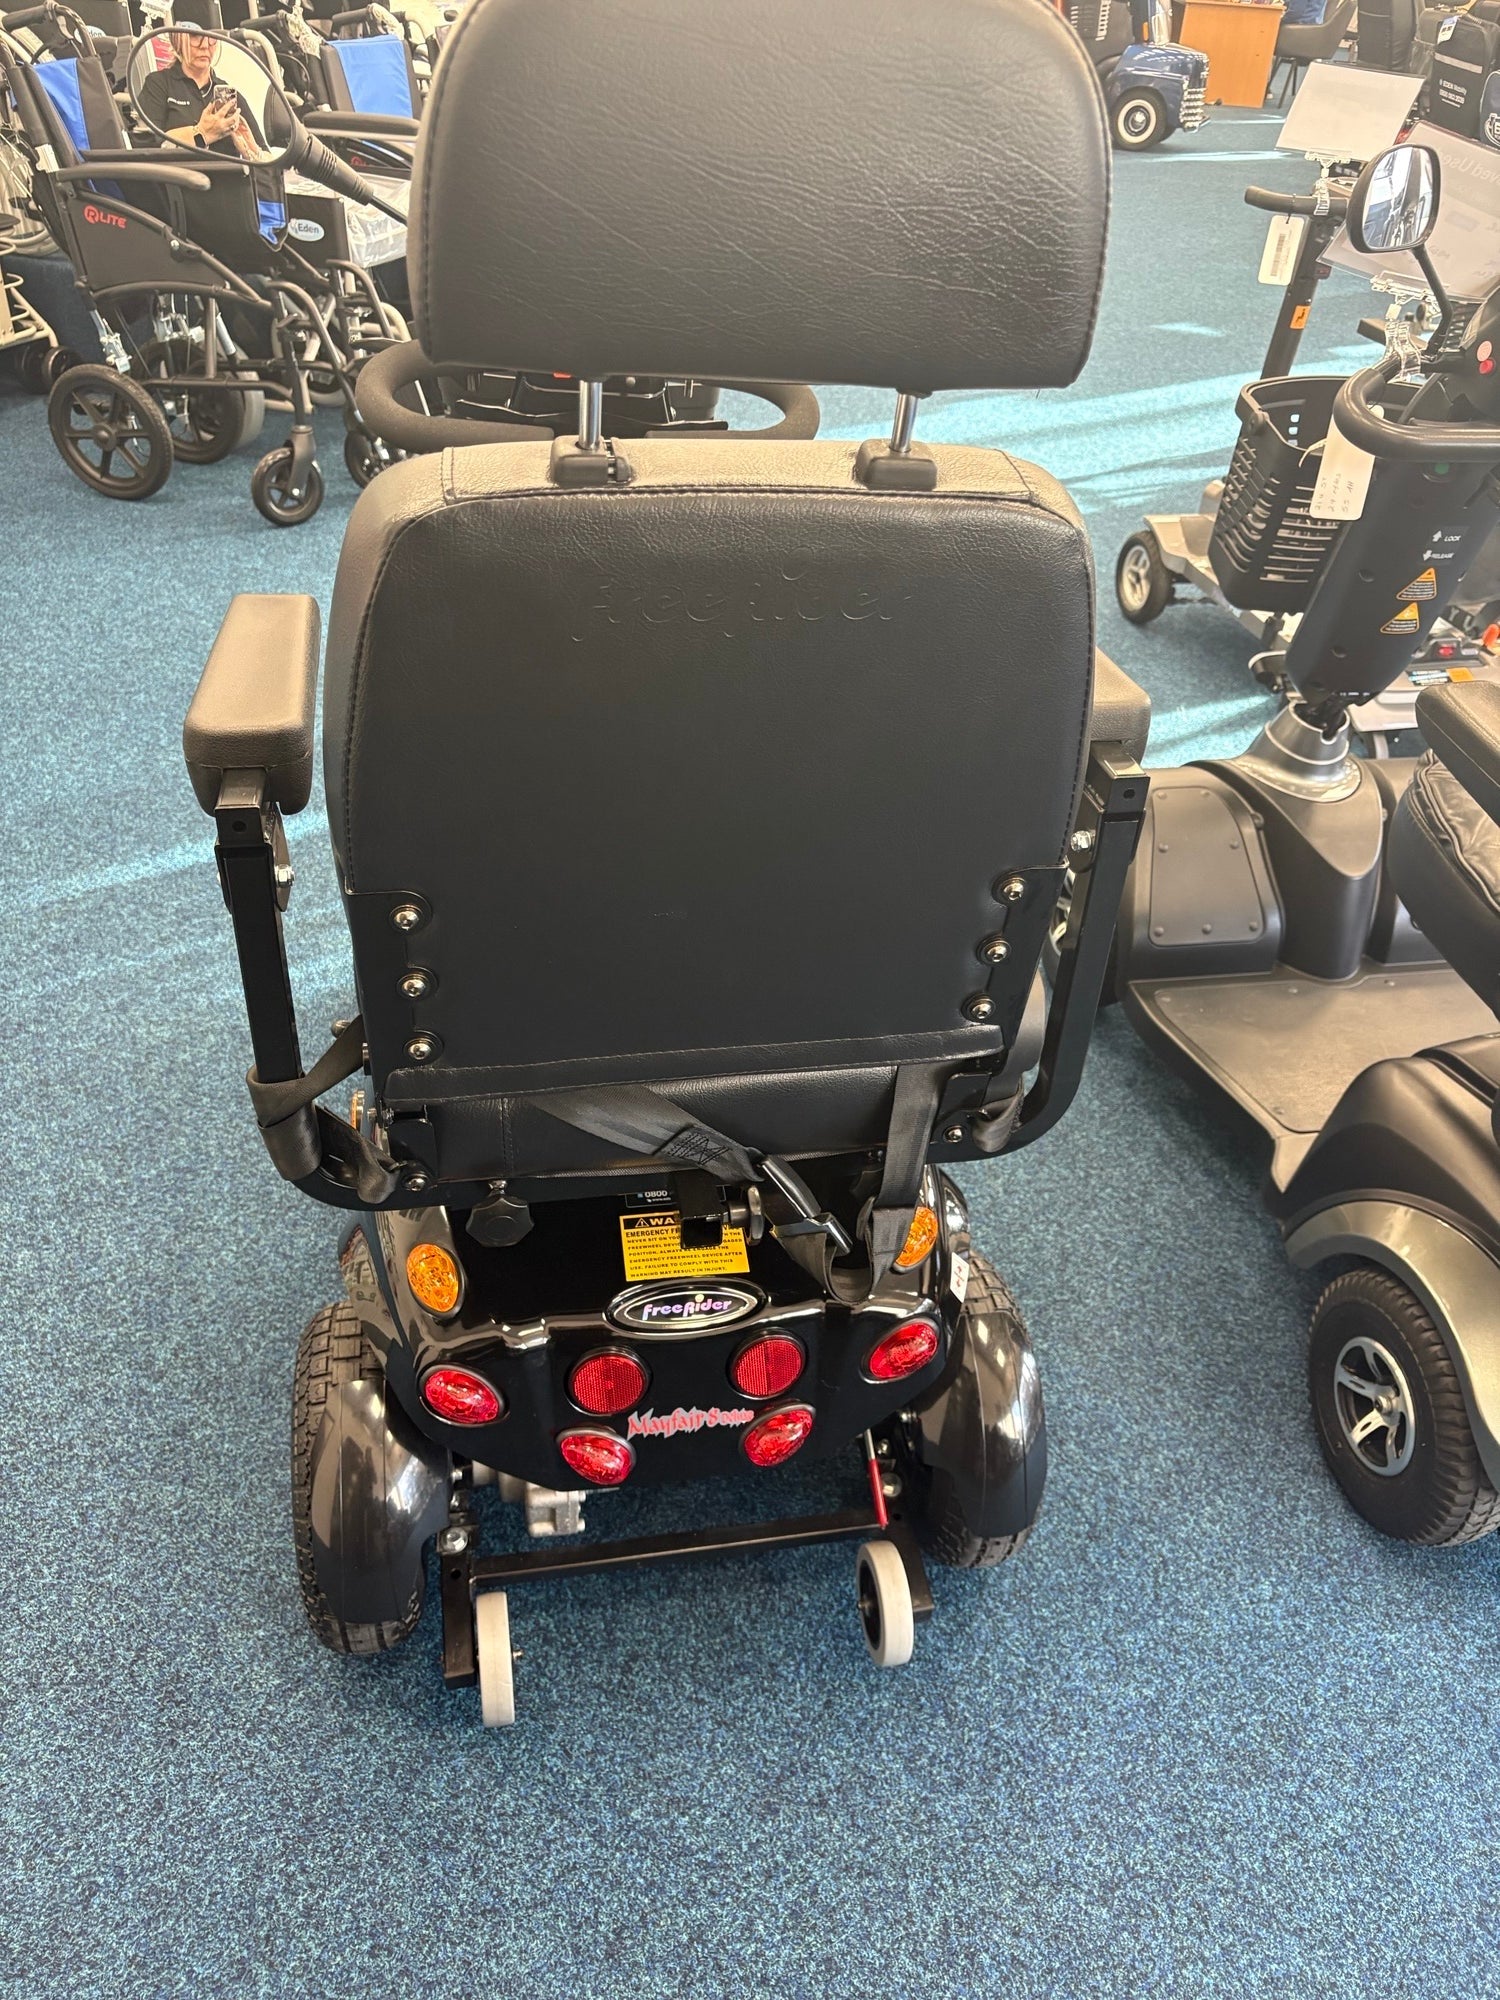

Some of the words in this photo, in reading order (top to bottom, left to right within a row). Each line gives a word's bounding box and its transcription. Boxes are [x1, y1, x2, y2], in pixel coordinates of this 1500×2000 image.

[297, 222, 320, 234] Eden
[625, 1228, 670, 1238] EMERGENCY
[627, 1406, 705, 1438] Mayfair
